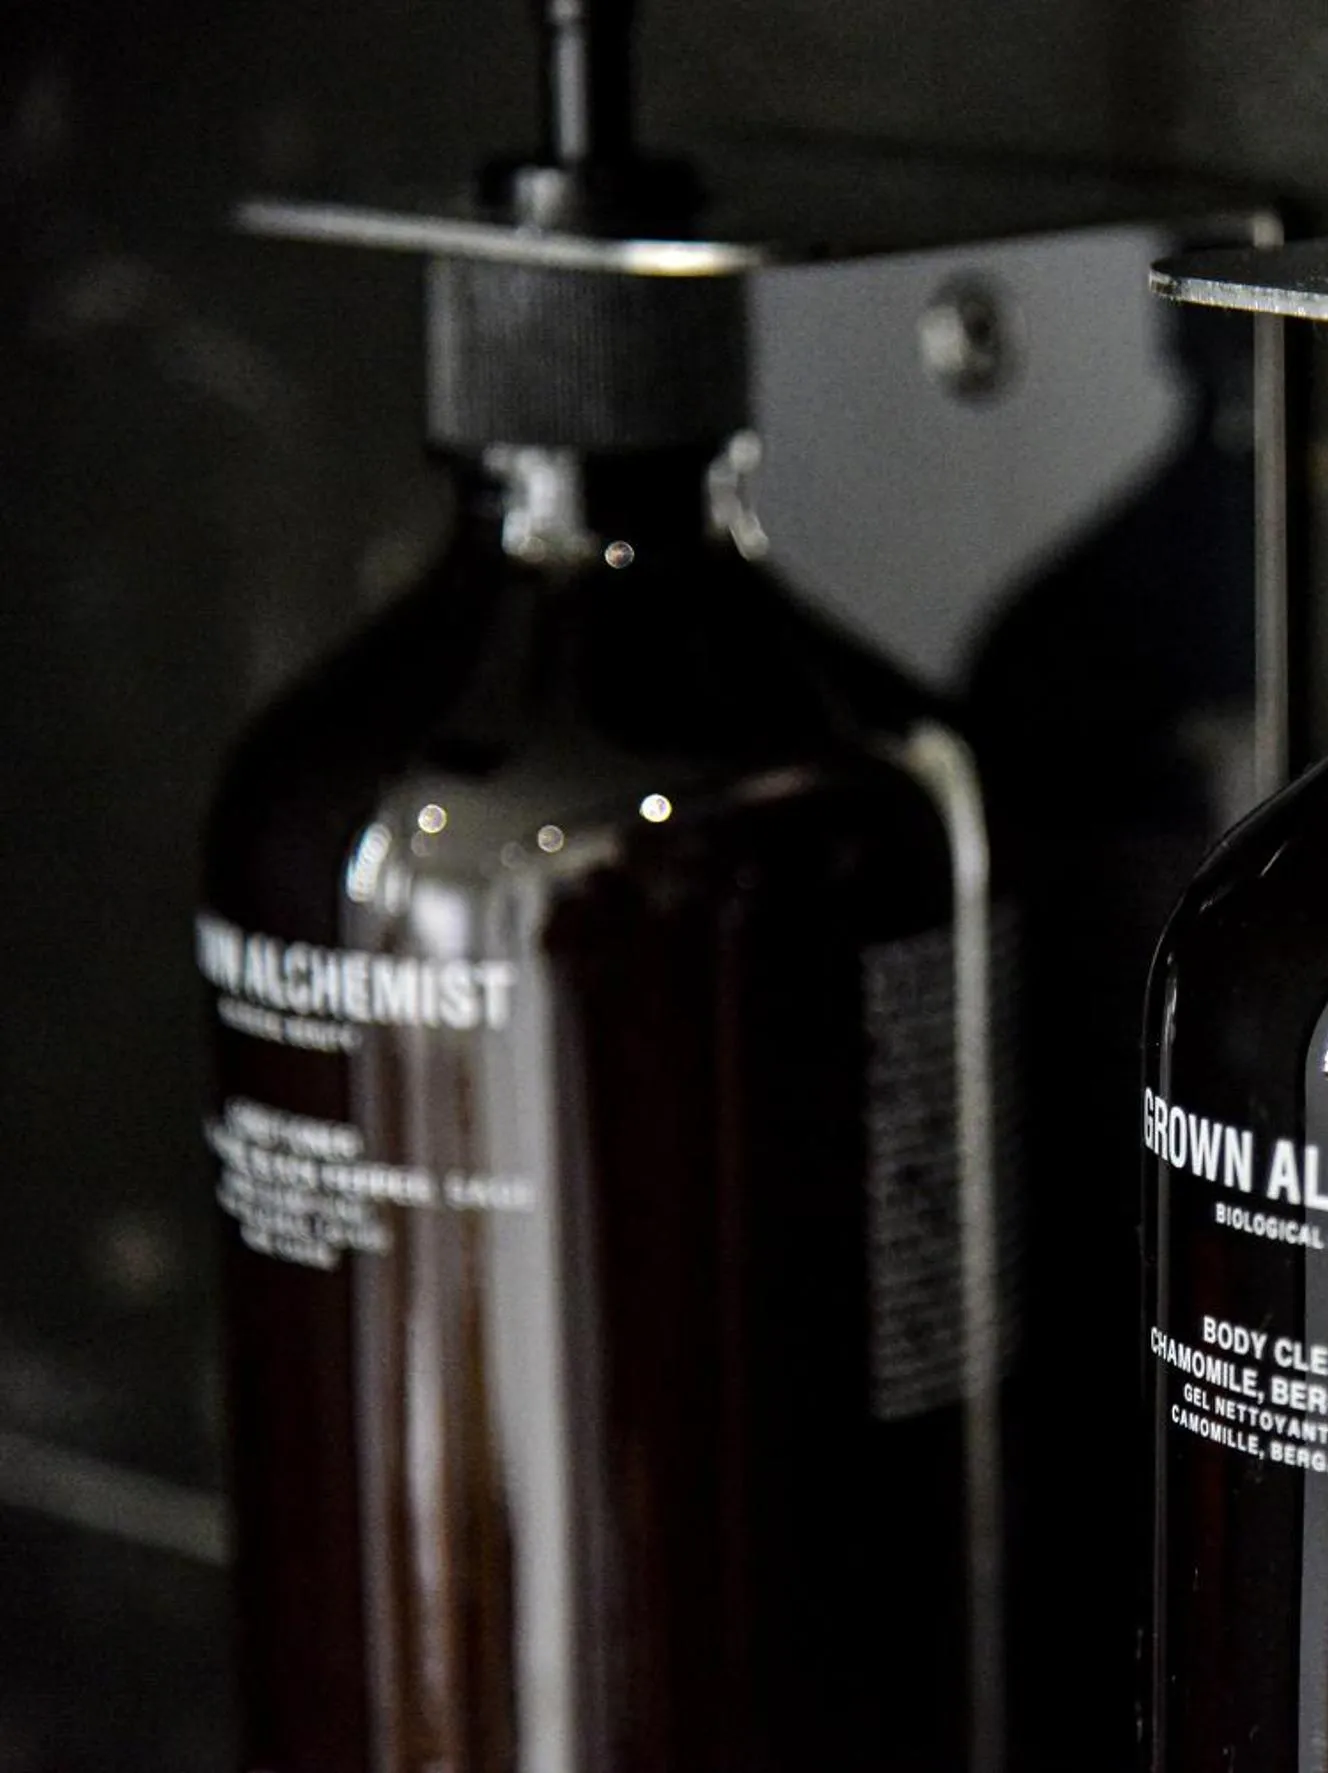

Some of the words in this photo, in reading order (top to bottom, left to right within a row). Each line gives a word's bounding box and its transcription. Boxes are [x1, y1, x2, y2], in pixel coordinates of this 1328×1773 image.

[1143, 1087, 1253, 1194] GROWN
[1215, 1202, 1324, 1250] BIOLOGICAL
[1203, 1315, 1269, 1361] BODY
[1150, 1326, 1266, 1404] CHAMOMILE,
[1184, 1382, 1211, 1420] GEL
[1171, 1404, 1266, 1460] CAMOMILLE,
